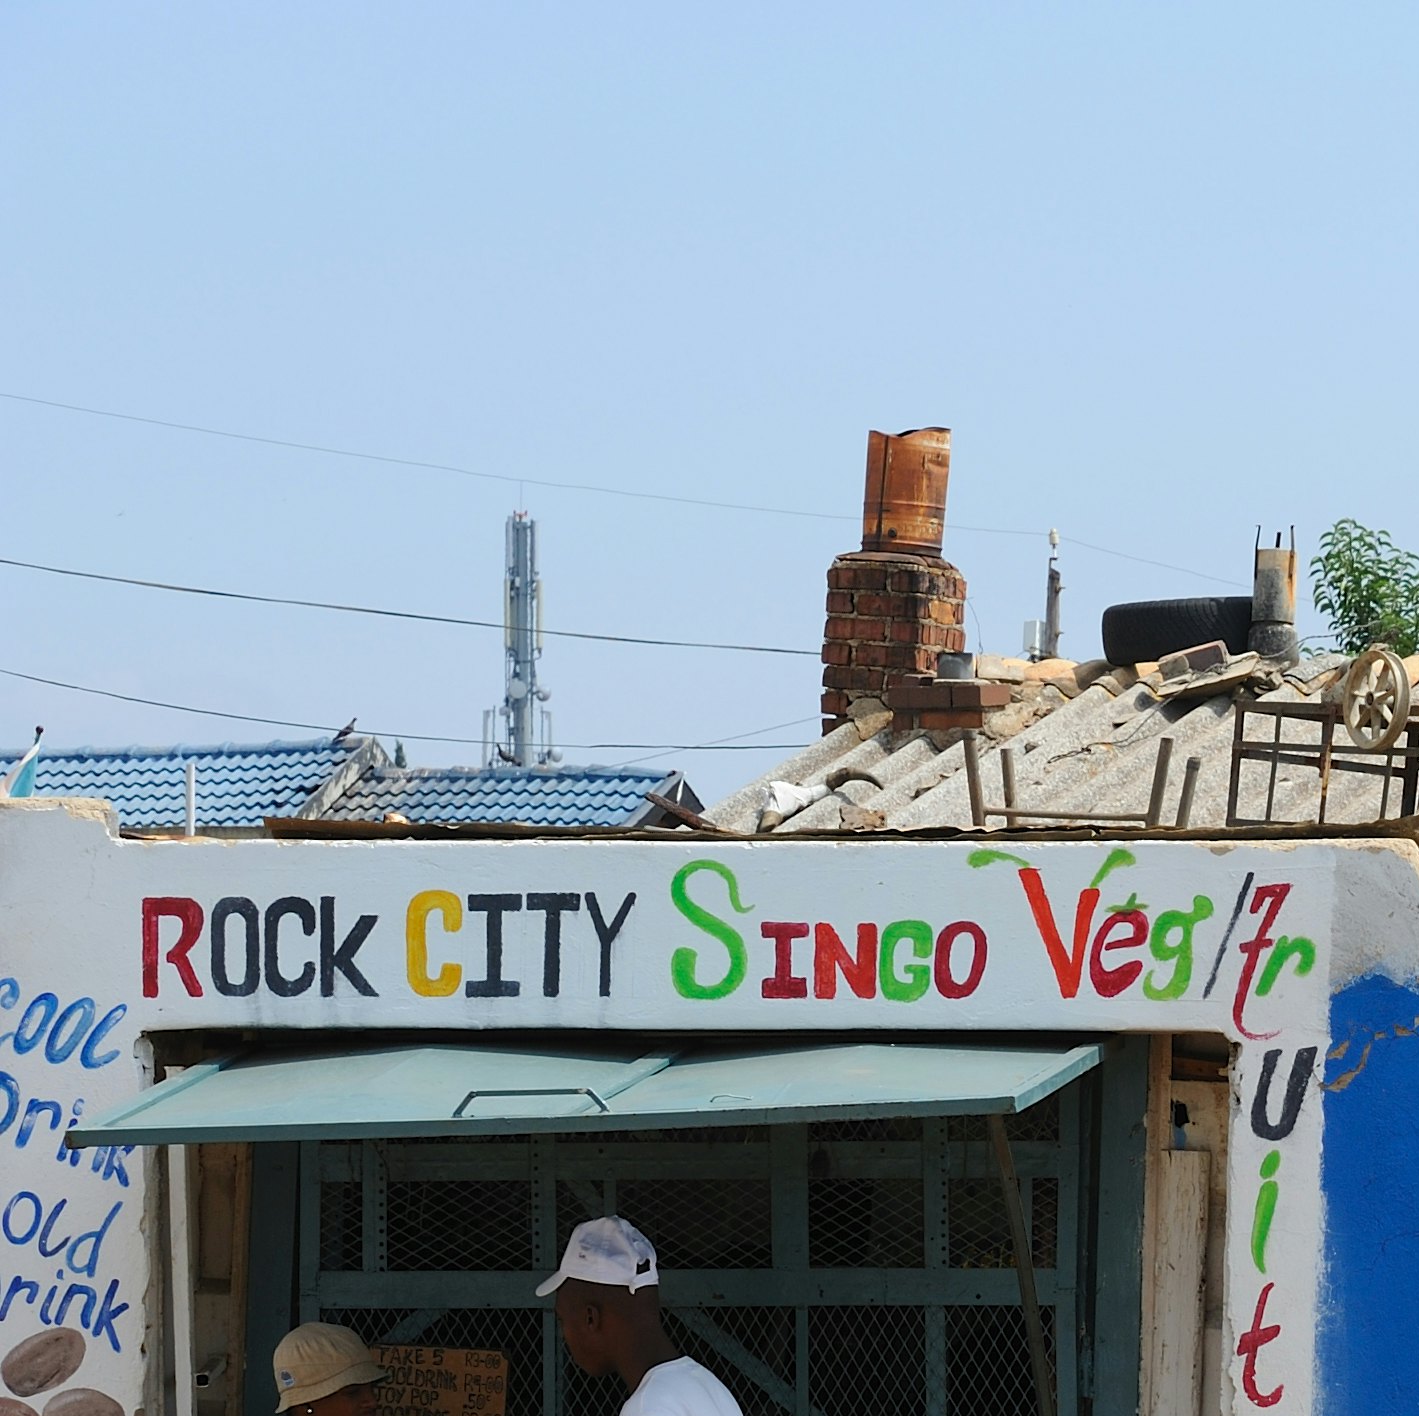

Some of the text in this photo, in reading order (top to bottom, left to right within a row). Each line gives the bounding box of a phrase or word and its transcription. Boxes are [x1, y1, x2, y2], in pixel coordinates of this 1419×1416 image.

[405, 889, 637, 998] CITY
[669, 858, 989, 1002] SINGO
[0, 1268, 130, 1353] rink
[377, 1365, 458, 1392] OOLDRINK
[379, 1347, 425, 1366] TAKE
[432, 1348, 445, 1366] 5
